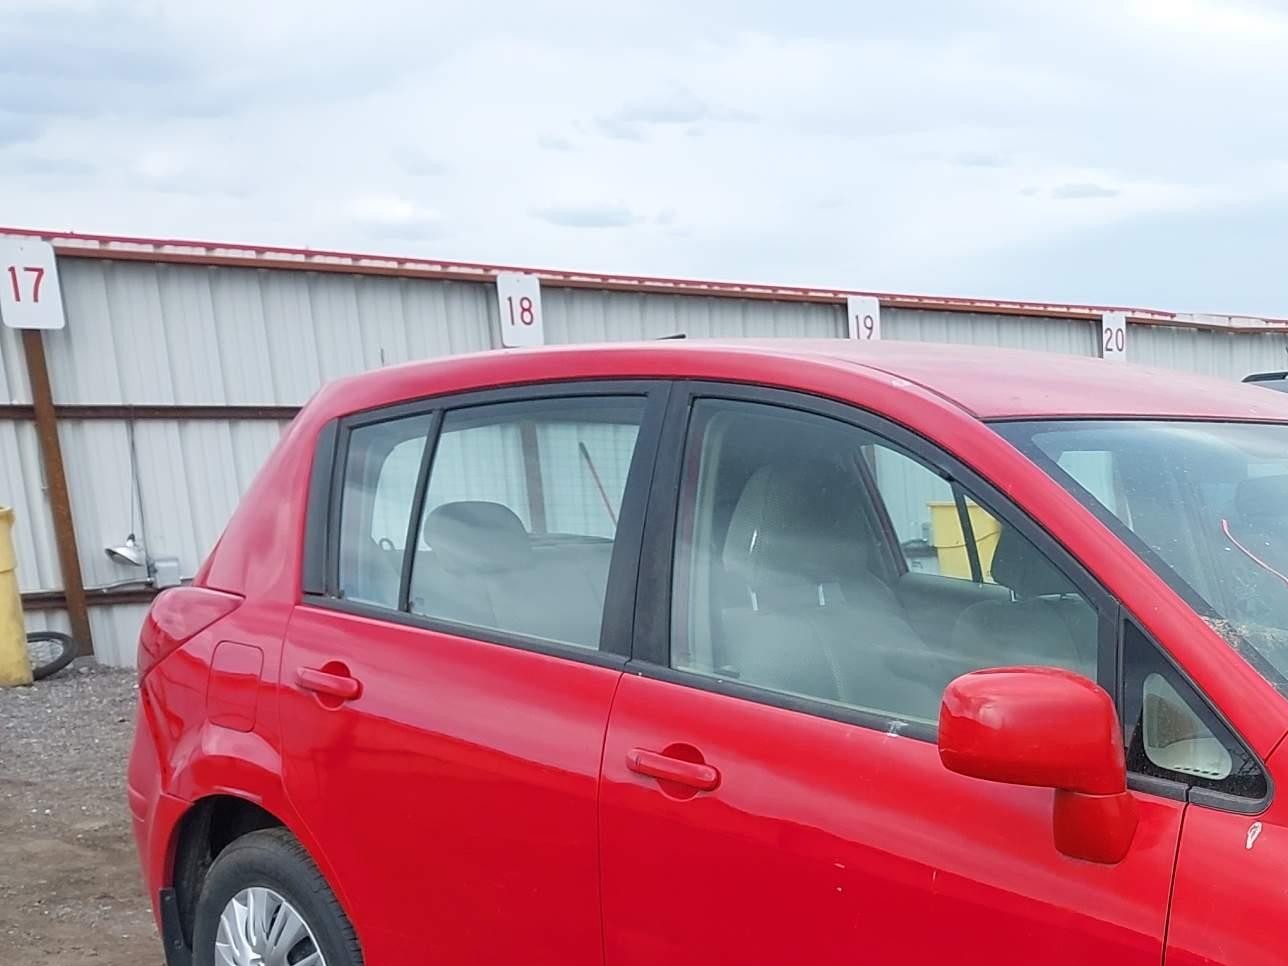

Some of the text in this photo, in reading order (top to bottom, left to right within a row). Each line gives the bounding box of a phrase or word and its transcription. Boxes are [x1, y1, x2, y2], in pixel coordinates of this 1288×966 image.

[8, 266, 44, 302] 17
[507, 296, 534, 326] 18
[855, 314, 874, 340] 19
[1104, 327, 1124, 352] 20
